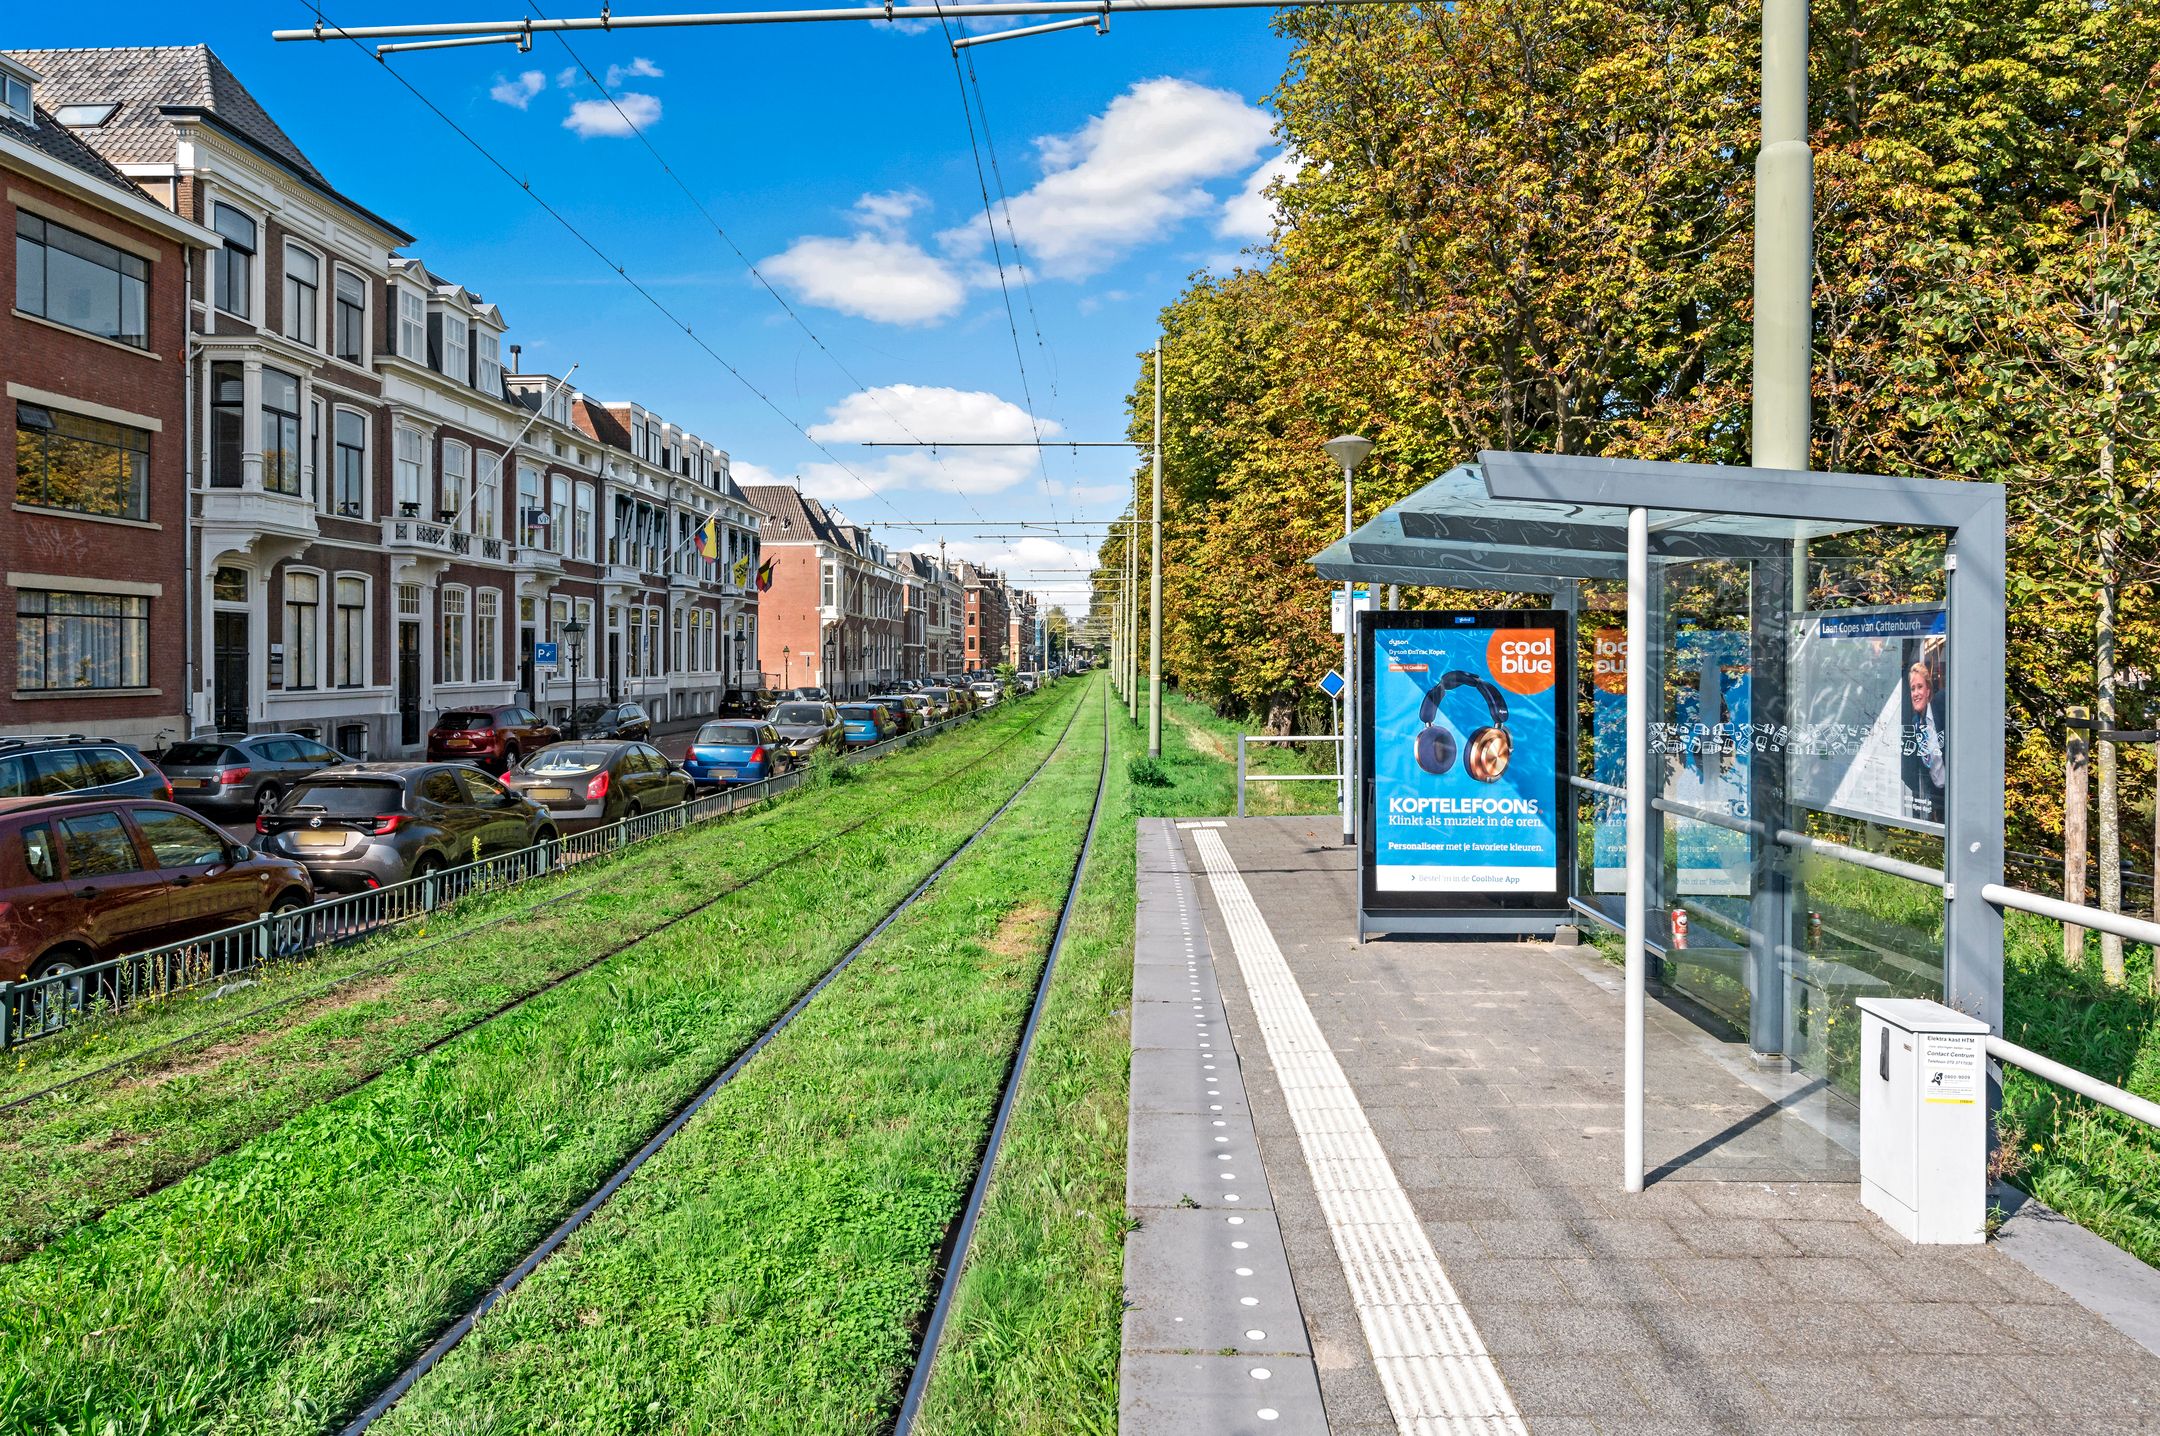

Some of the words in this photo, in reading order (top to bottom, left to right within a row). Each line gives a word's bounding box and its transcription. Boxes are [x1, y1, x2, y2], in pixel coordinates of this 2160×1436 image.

[1822, 623, 1838, 634] Laan
[1839, 622, 1860, 635] Copes
[1861, 622, 1874, 632] van
[1875, 618, 1921, 633] Cattenburch
[1501, 637, 1552, 655] cool
[538, 649, 545, 658] P
[1501, 655, 1552, 674] blue
[1389, 797, 1543, 815] KOPTELEFOONS.
[1388, 815, 1424, 826] Klinkt
[1425, 815, 1441, 826] als
[1443, 815, 1485, 827] muziek
[1487, 815, 1498, 827] in
[1500, 816, 1513, 827] de
[1516, 818, 1544, 827] oren.
[1388, 842, 1445, 851] Personaliseer
[1446, 843, 1462, 851] met
[1463, 842, 1471, 852] je
[1472, 842, 1508, 852] favoriete
[1509, 842, 1544, 852] kleuren.
[1419, 874, 1441, 882] Bestel
[1471, 875, 1504, 883] Coolblue
[1505, 876, 1520, 885] App
